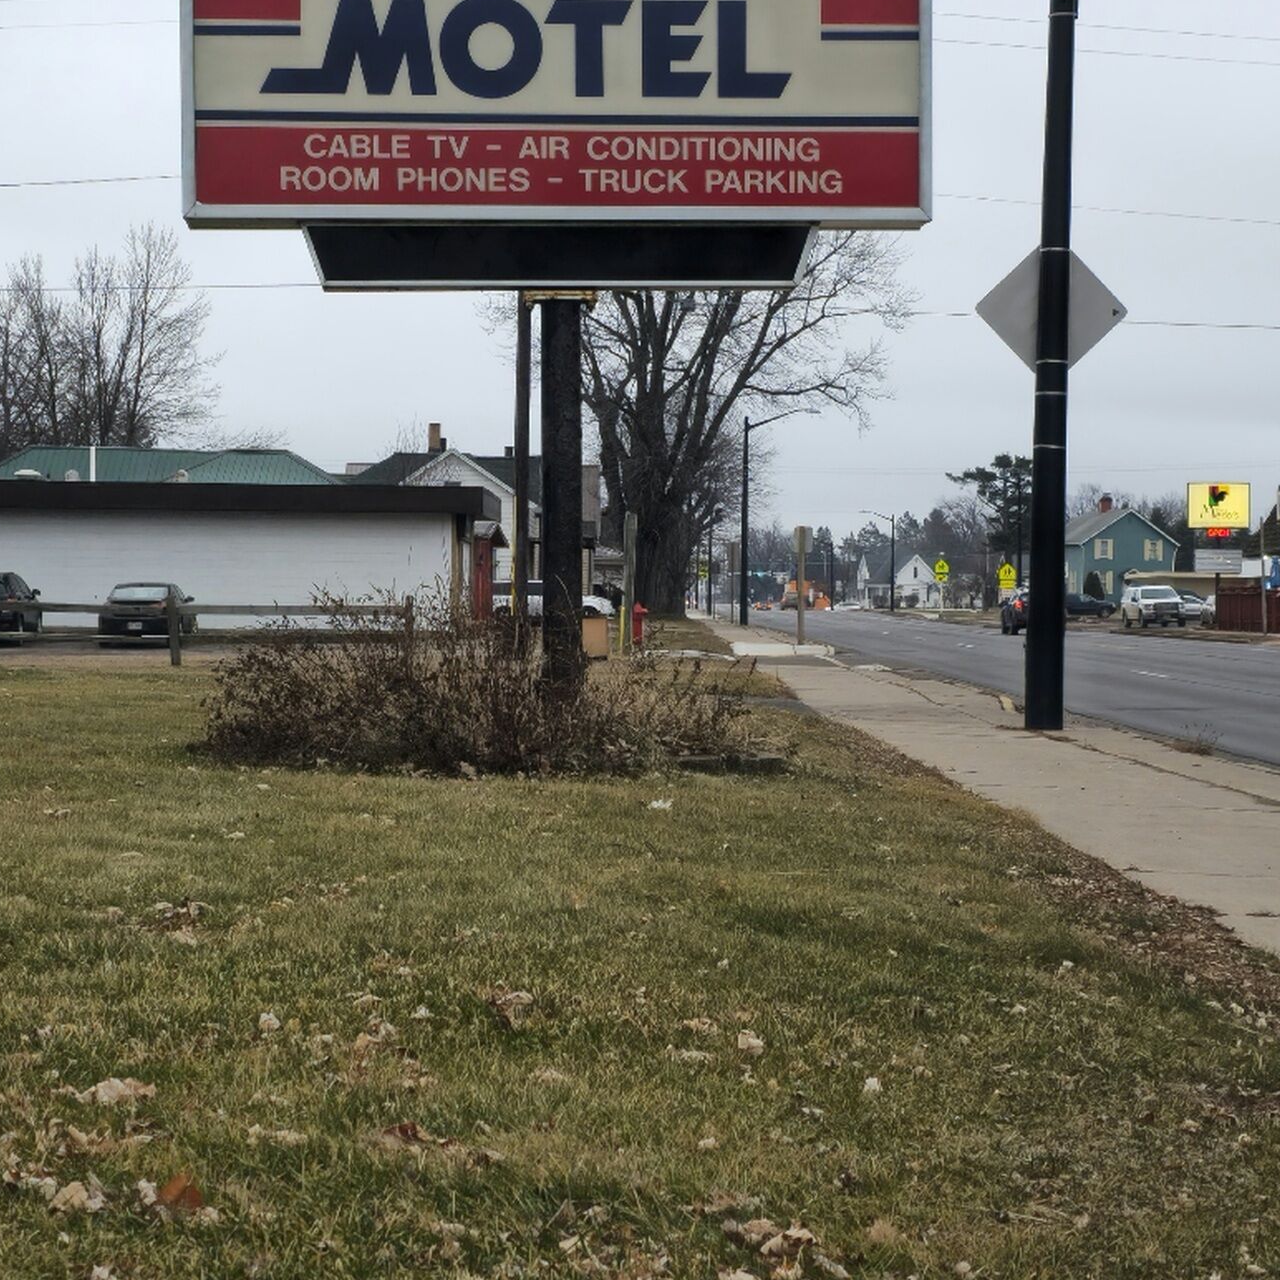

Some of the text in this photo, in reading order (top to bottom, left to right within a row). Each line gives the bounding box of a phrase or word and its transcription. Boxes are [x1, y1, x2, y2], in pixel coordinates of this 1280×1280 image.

[303, 133, 411, 160] CABLE
[426, 135, 469, 160] TV
[518, 136, 570, 160] AIR
[586, 136, 820, 162] CONDITIONING
[280, 166, 380, 192] ROOM
[397, 167, 530, 192] PHONES
[578, 169, 688, 194] TRUCK
[705, 169, 843, 194] PARKING
